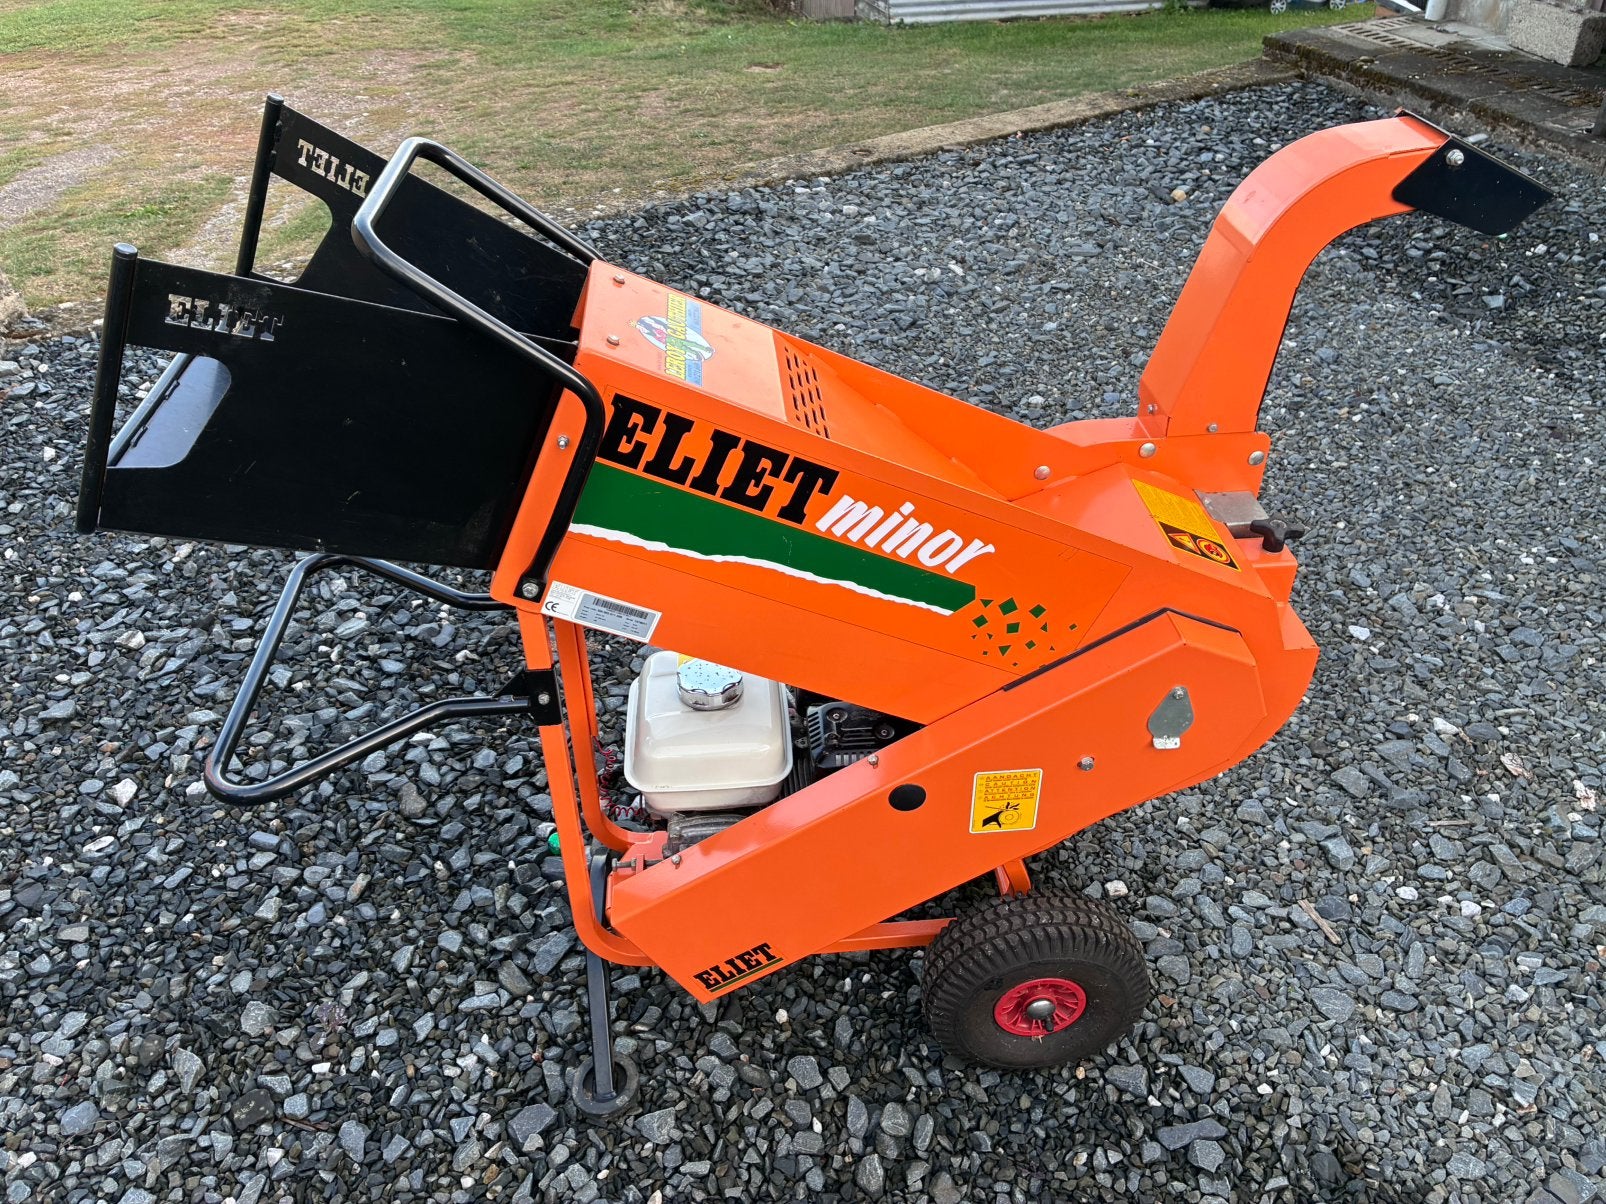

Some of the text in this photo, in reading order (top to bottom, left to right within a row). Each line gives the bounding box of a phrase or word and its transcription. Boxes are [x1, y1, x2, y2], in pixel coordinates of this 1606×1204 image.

[164, 293, 285, 342] ELIET
[665, 344, 686, 380] LEROY
[596, 392, 996, 574] ELIET minor
[693, 942, 777, 990] ELIET
